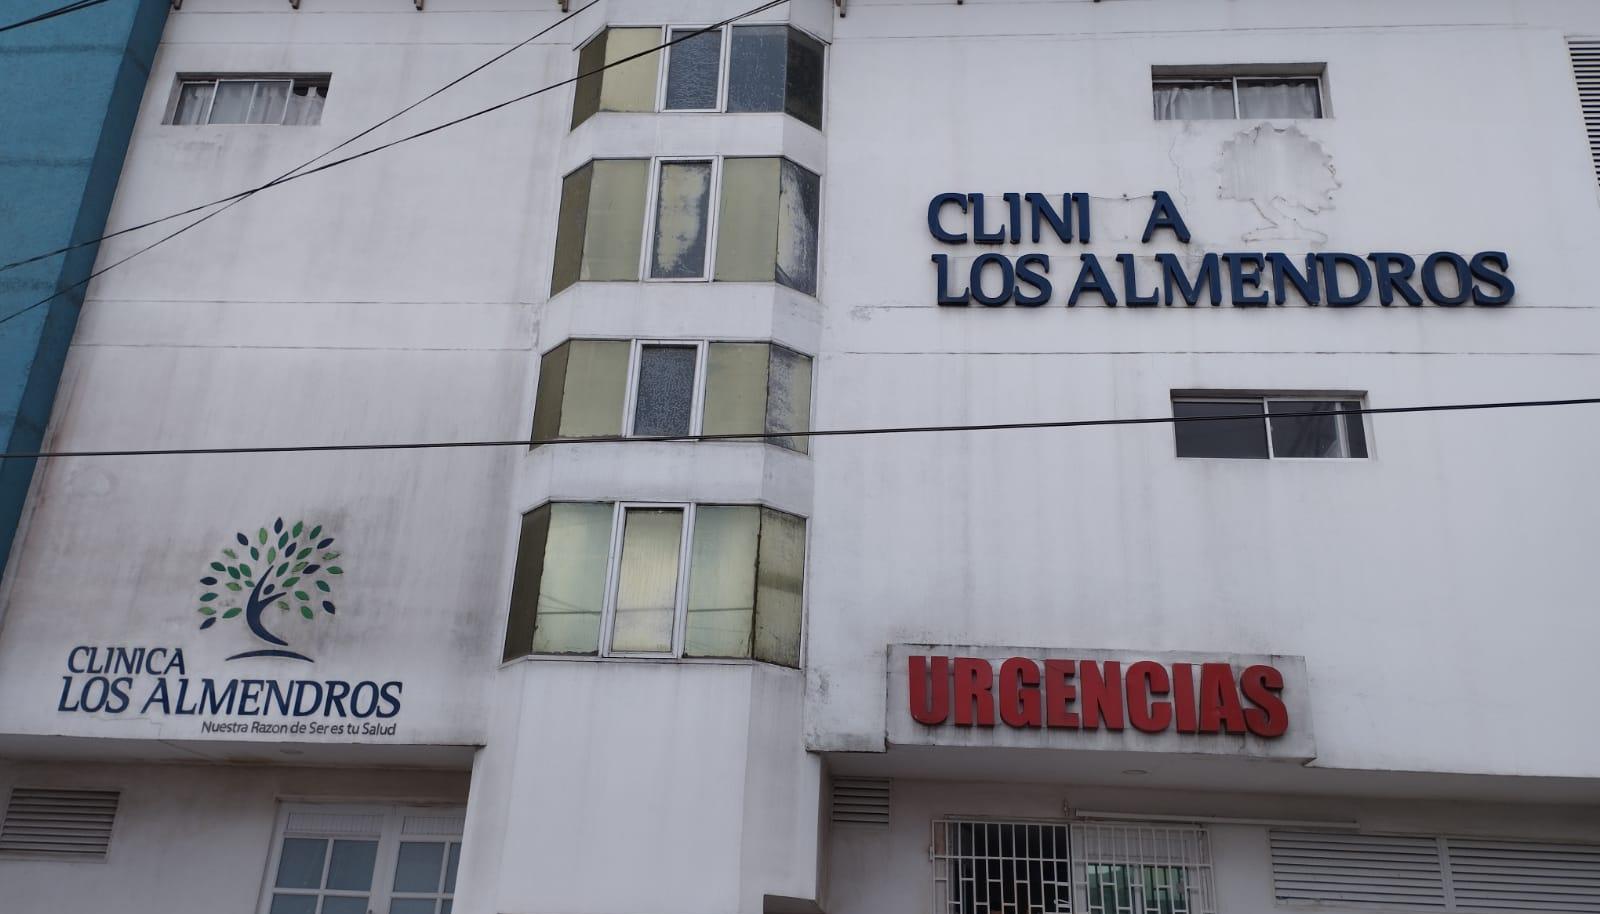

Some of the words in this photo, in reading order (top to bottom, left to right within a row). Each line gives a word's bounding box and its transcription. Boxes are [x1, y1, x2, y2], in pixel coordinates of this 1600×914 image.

[931, 252, 1052, 307] LOS
[1067, 251, 1515, 307] ALMENDROS
[67, 645, 186, 675] CLINICA
[57, 675, 133, 713] LOS
[140, 677, 403, 719] ALMENDROS
[908, 655, 1288, 738] URGENCIAS
[201, 721, 248, 734] Nuestra
[251, 721, 288, 734] Razon
[290, 721, 306, 734] de
[347, 723, 360, 735] tu
[362, 723, 397, 736] Salud
